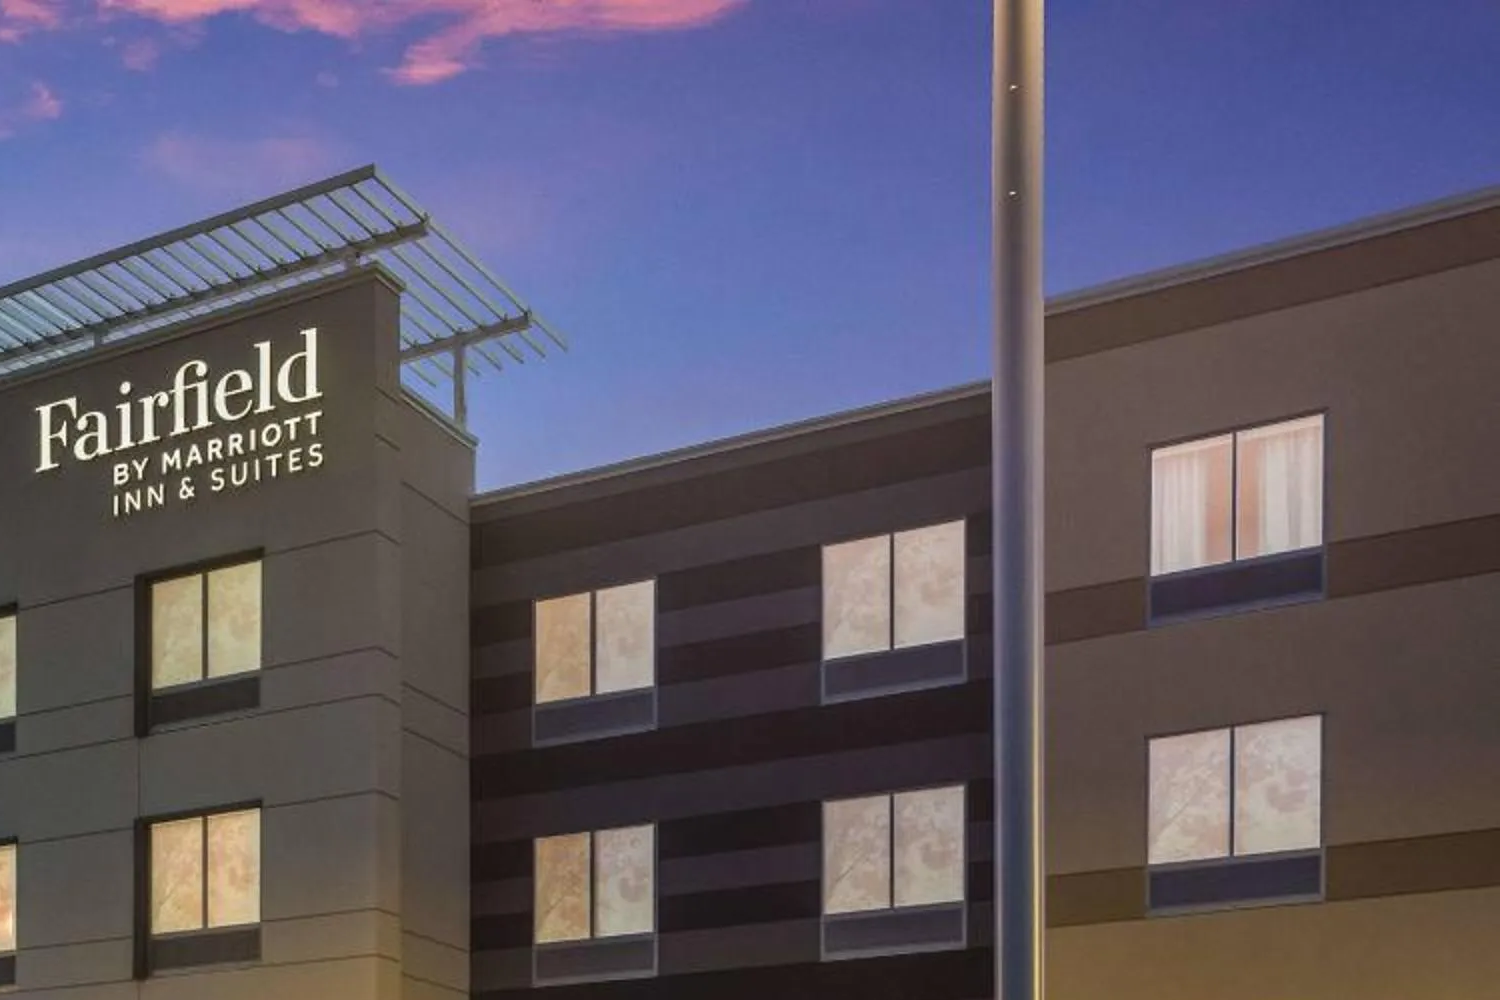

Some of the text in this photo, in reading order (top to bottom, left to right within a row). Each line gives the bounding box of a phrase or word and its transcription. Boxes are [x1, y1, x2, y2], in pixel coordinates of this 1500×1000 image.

[34, 326, 324, 474] Fairfield
[112, 410, 323, 487] BY MARRIOTT
[112, 442, 325, 518] INN & SUITES
